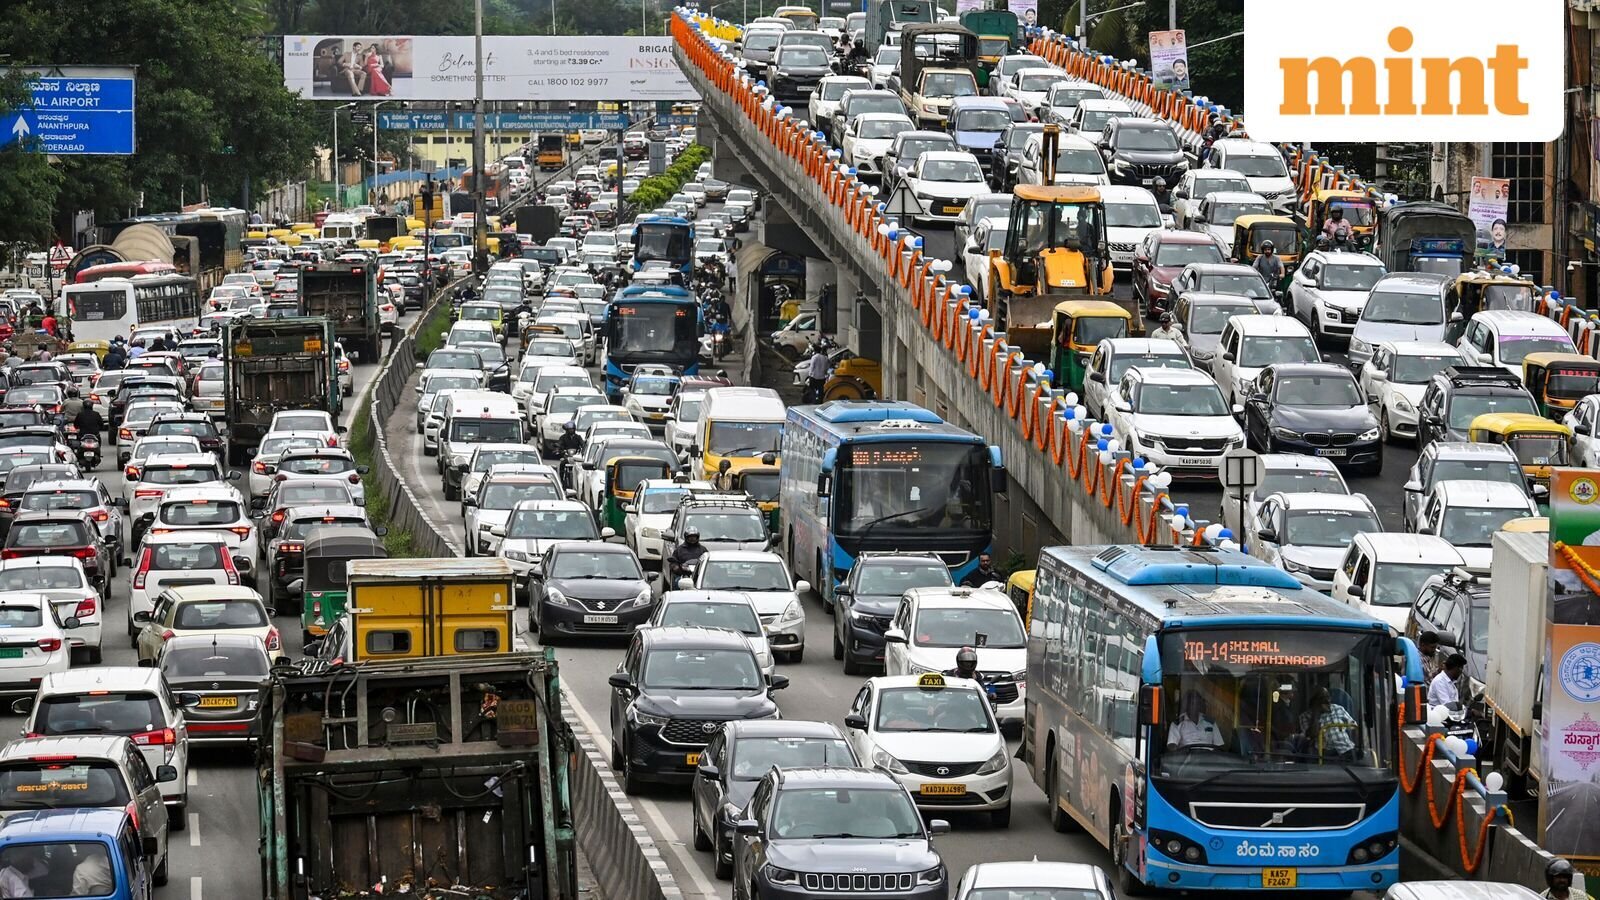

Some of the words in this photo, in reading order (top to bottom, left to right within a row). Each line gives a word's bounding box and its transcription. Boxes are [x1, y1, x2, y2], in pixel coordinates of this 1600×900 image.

[630, 58, 678, 68] INSIGN
[547, 78, 568, 86] 1800
[570, 78, 585, 86] 102
[587, 78, 608, 86] 9977
[51, 97, 101, 107] AIRPORT
[37, 122, 90, 130] ANANTHPURA
[1251, 641, 1280, 652] MALL
[1229, 654, 1326, 665] SHANTHINAGAR
[1564, 733, 1600, 750] ಸುಸ್ವಾಗ
[1270, 869, 1289, 878] KA57
